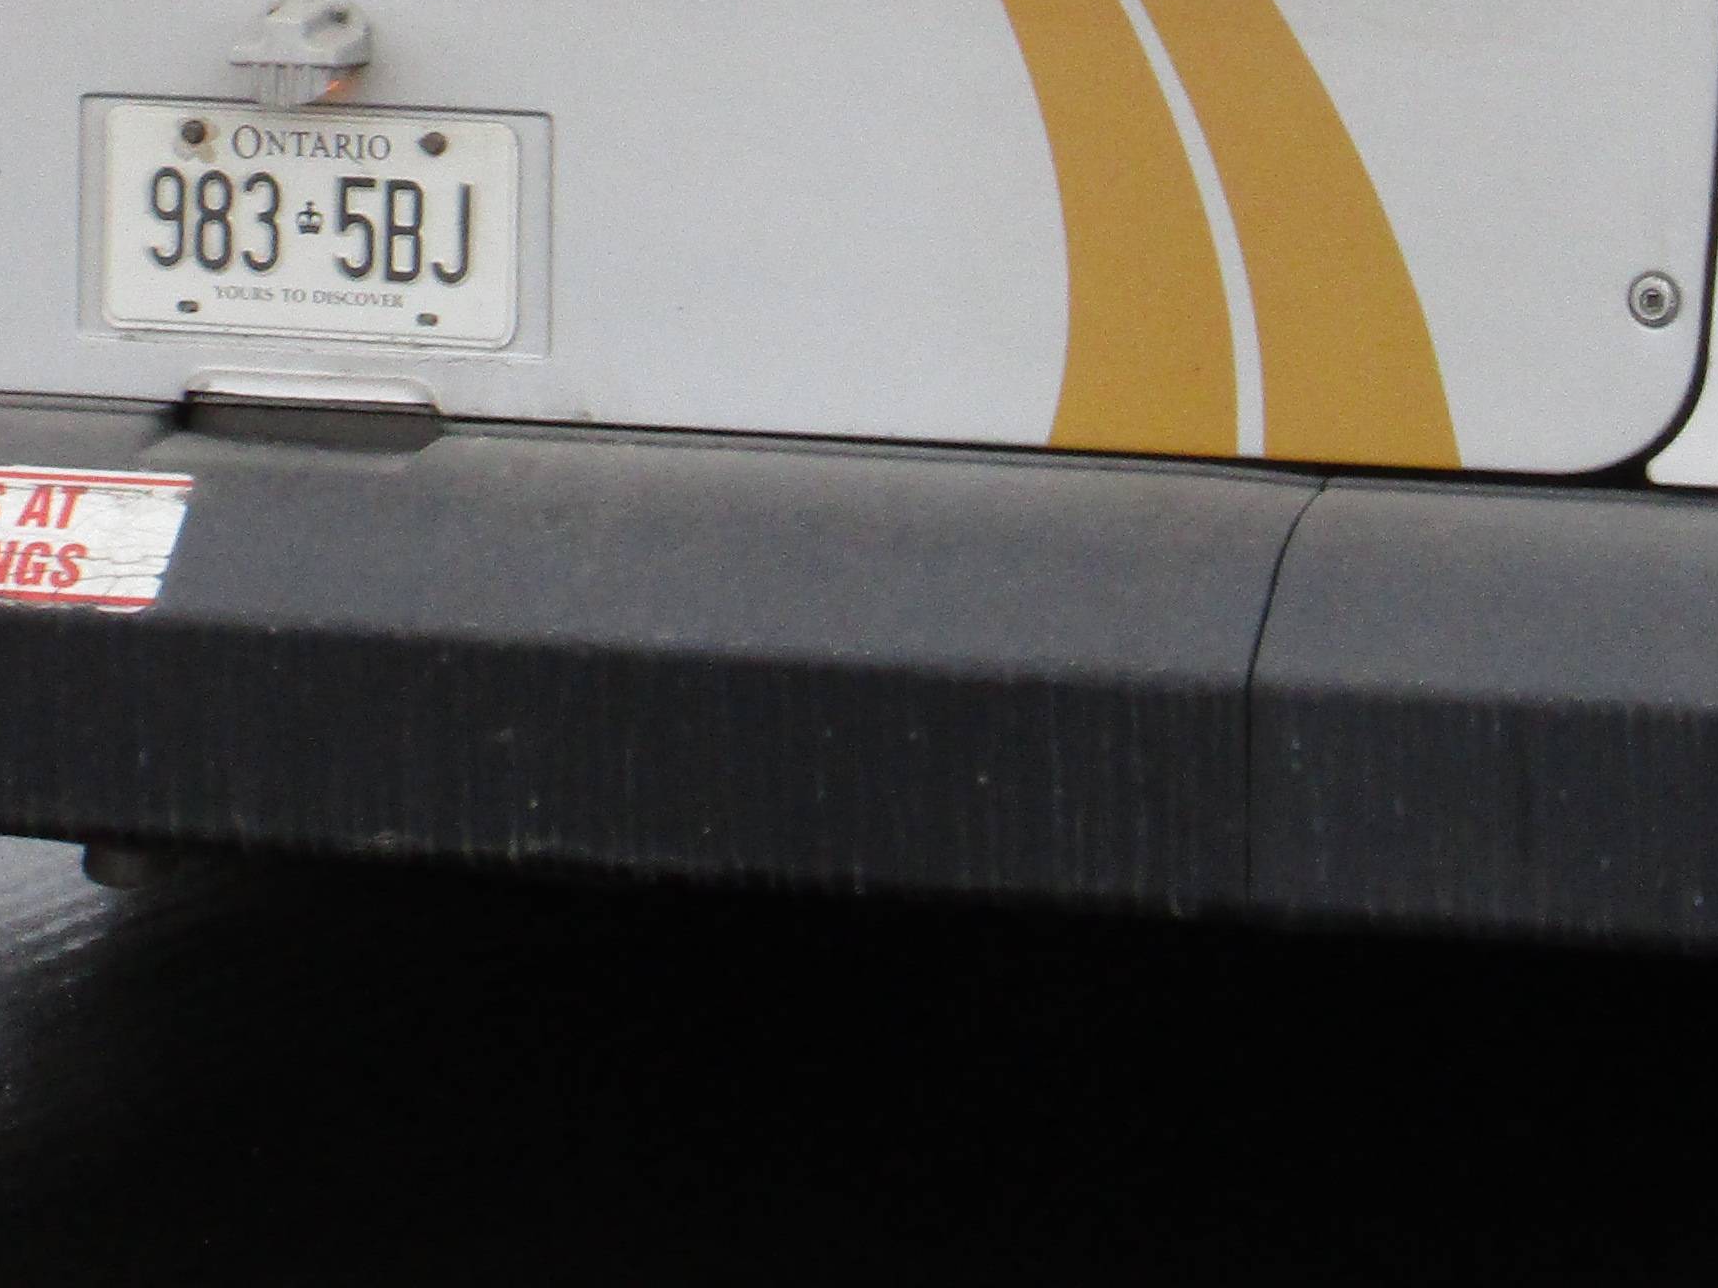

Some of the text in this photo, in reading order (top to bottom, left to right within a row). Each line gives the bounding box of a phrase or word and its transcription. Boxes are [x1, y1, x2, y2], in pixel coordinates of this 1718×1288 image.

[149, 166, 473, 285] 983 5BJ
[215, 285, 406, 309] YOURS TO DISCOVER
[15, 484, 89, 530] AT
